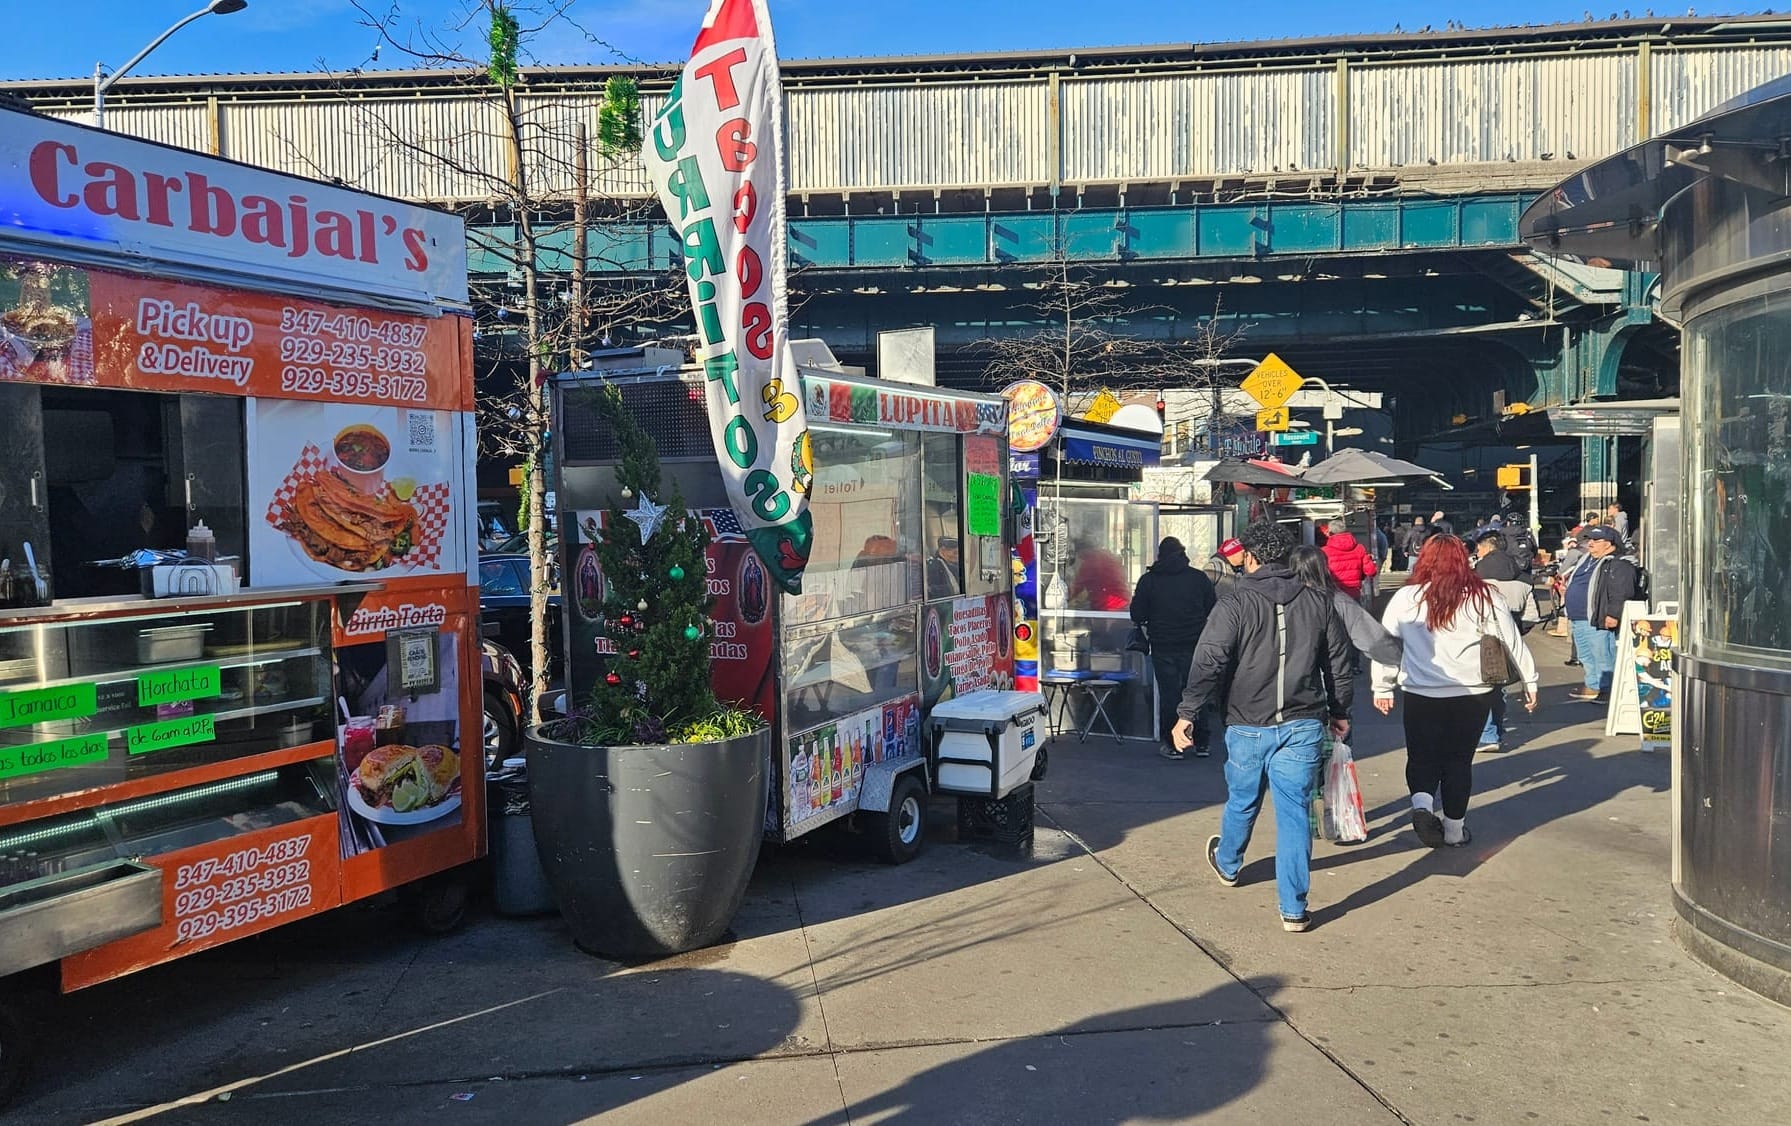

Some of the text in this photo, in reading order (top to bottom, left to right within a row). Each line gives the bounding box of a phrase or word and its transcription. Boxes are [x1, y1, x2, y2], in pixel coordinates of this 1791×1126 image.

[29, 140, 430, 272] Carbajal's
[281, 307, 426, 347] 347-410-4837
[138, 342, 254, 385] & Delivery
[281, 338, 426, 374] 929-235-3932
[281, 366, 427, 401] 929-395-3172
[1256, 370, 1288, 379] VEHICLES
[1262, 380, 1283, 388] OVER
[880, 393, 954, 428] LUPITA
[346, 603, 446, 635] Birria Torta
[948, 622, 966, 637] Tacos
[140, 672, 209, 700] Horchata
[152, 728, 180, 742] 6am
[21, 747, 57, 767] todos
[175, 834, 312, 890] 347-410-4837
[175, 860, 310, 917] 929-235-3932
[176, 884, 312, 942] 929-395-3172
